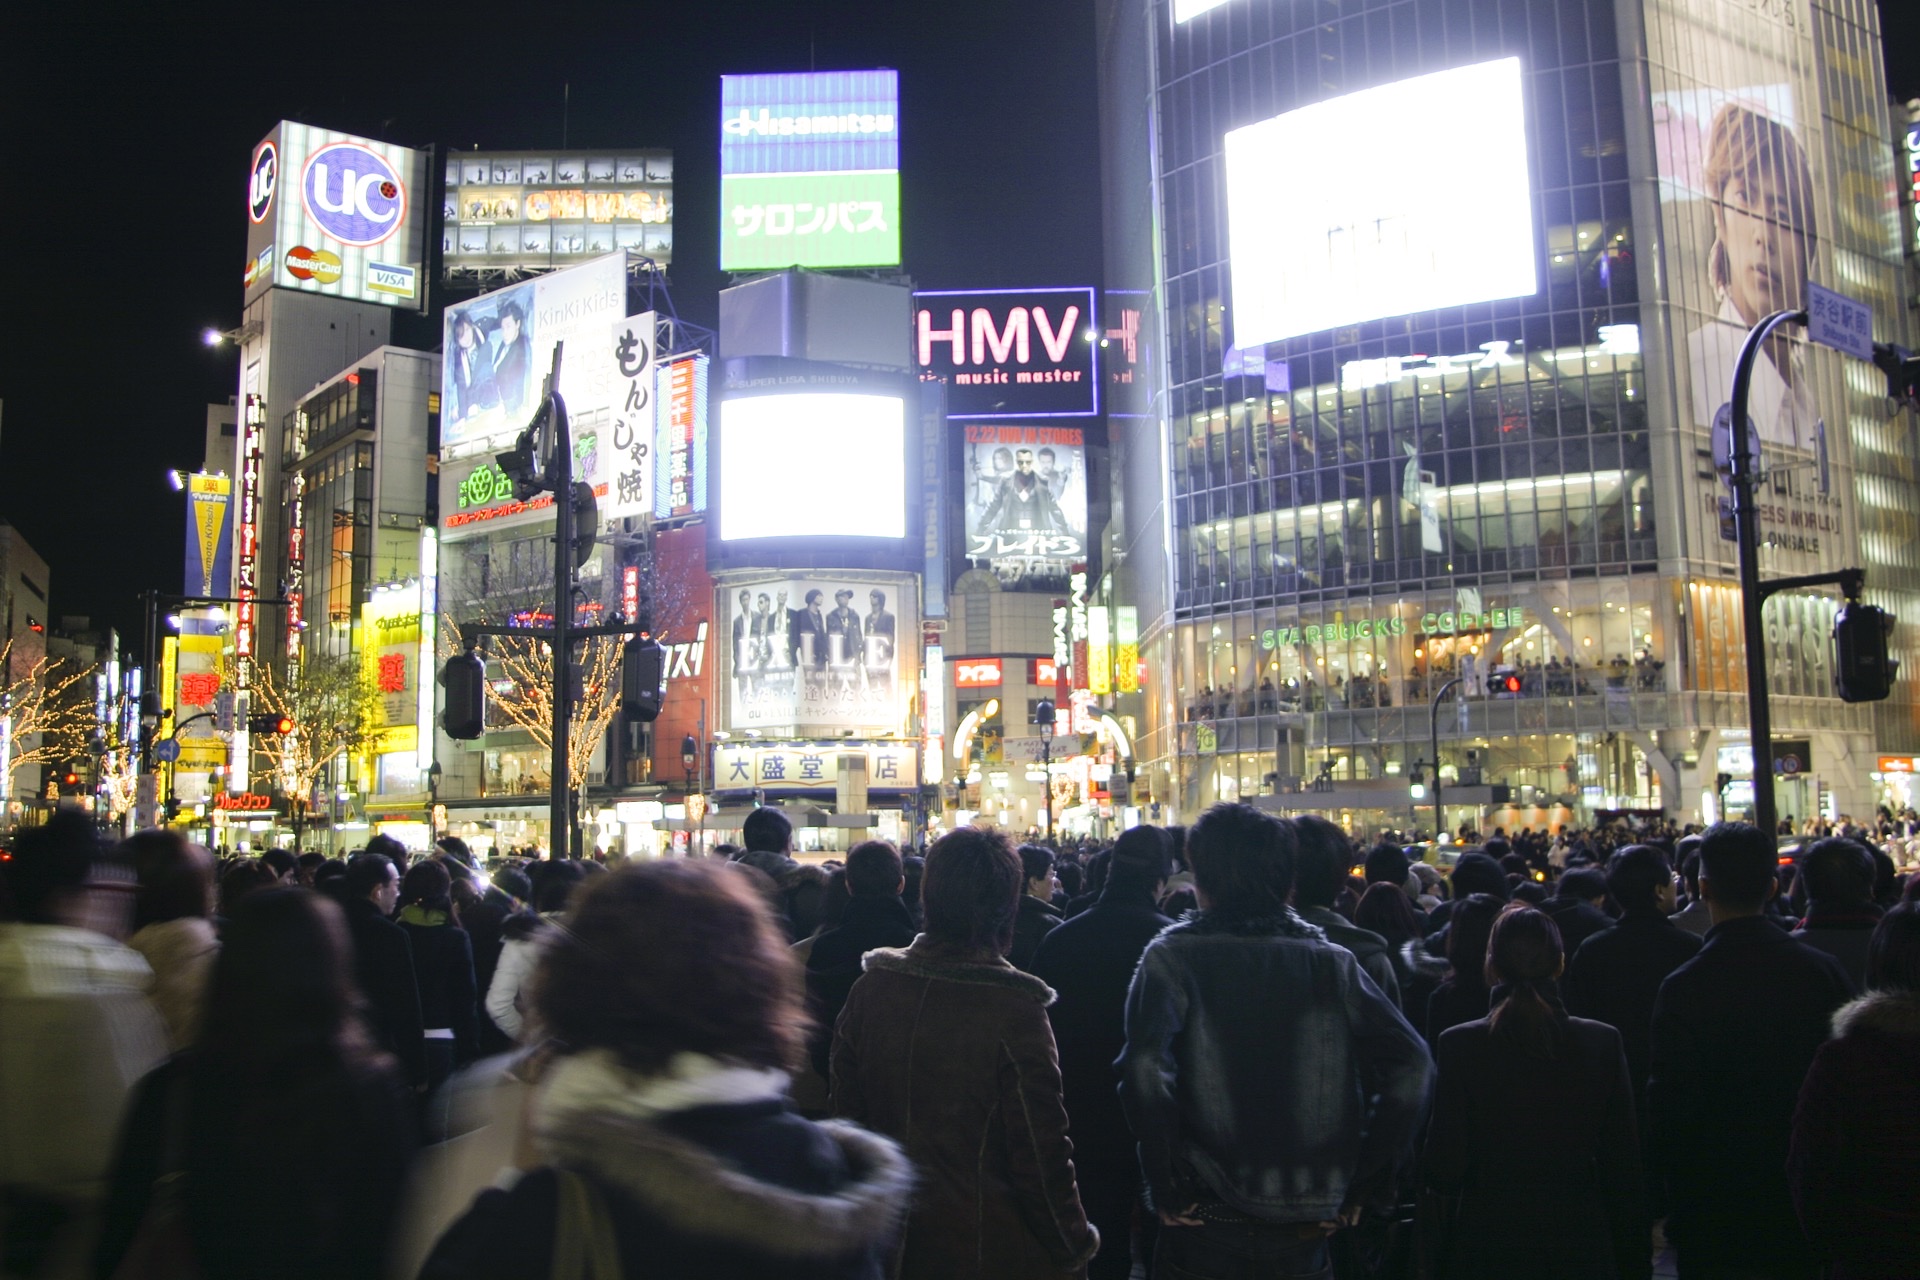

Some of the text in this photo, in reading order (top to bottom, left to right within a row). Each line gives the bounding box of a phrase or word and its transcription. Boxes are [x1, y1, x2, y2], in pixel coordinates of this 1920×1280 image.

[722, 108, 894, 137] Hisamitsu
[731, 200, 889, 237] サロンパス
[286, 255, 341, 274] MasterCard
[376, 271, 406, 287] VISA
[539, 289, 620, 329] KinKi Kids
[1812, 291, 1868, 337] 渋谷駅前
[918, 305, 1080, 367] HMV
[810, 375, 859, 385] SHIBUYA
[956, 368, 1009, 385] music
[1016, 369, 1081, 384] master
[615, 329, 649, 506] もんじゃ焼
[964, 426, 995, 443] 12.22
[998, 426, 1021, 443] DVD
[1040, 428, 1083, 445] STORES
[670, 367, 688, 507] 三千里薬品
[202, 504, 214, 597] Matsumoto KiYoshi
[1262, 607, 1523, 649] STARBUCKS COFFEE
[738, 633, 893, 671] EXILE
[181, 673, 221, 706] 薬
[378, 652, 405, 693] 薬
[749, 711, 761, 719] au
[730, 755, 898, 781] 大盛堂店
